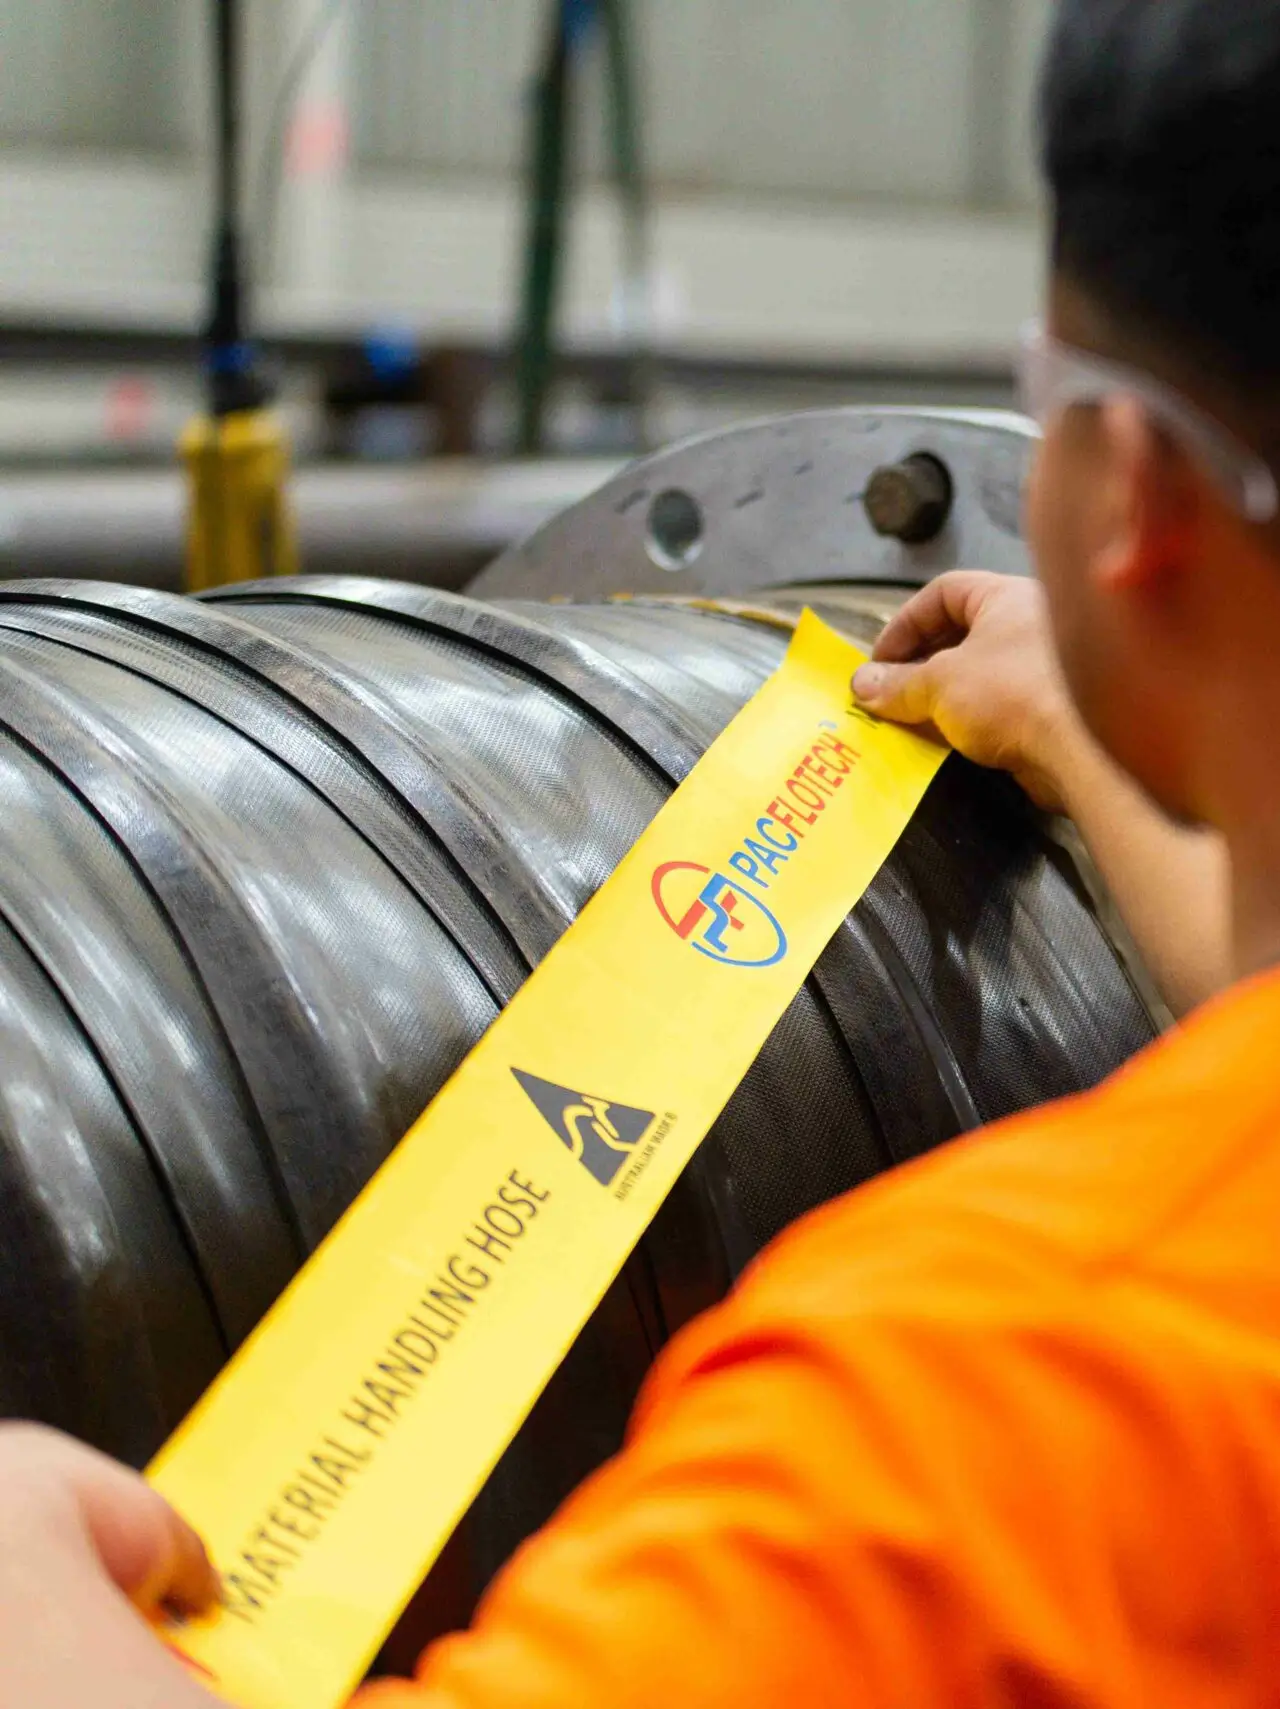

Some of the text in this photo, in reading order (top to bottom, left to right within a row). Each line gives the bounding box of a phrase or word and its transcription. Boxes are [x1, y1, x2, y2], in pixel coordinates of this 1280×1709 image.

[728, 731, 861, 888] PACFLOTECH
[221, 1168, 551, 1625] MATERIAL HANDLING HOSE
